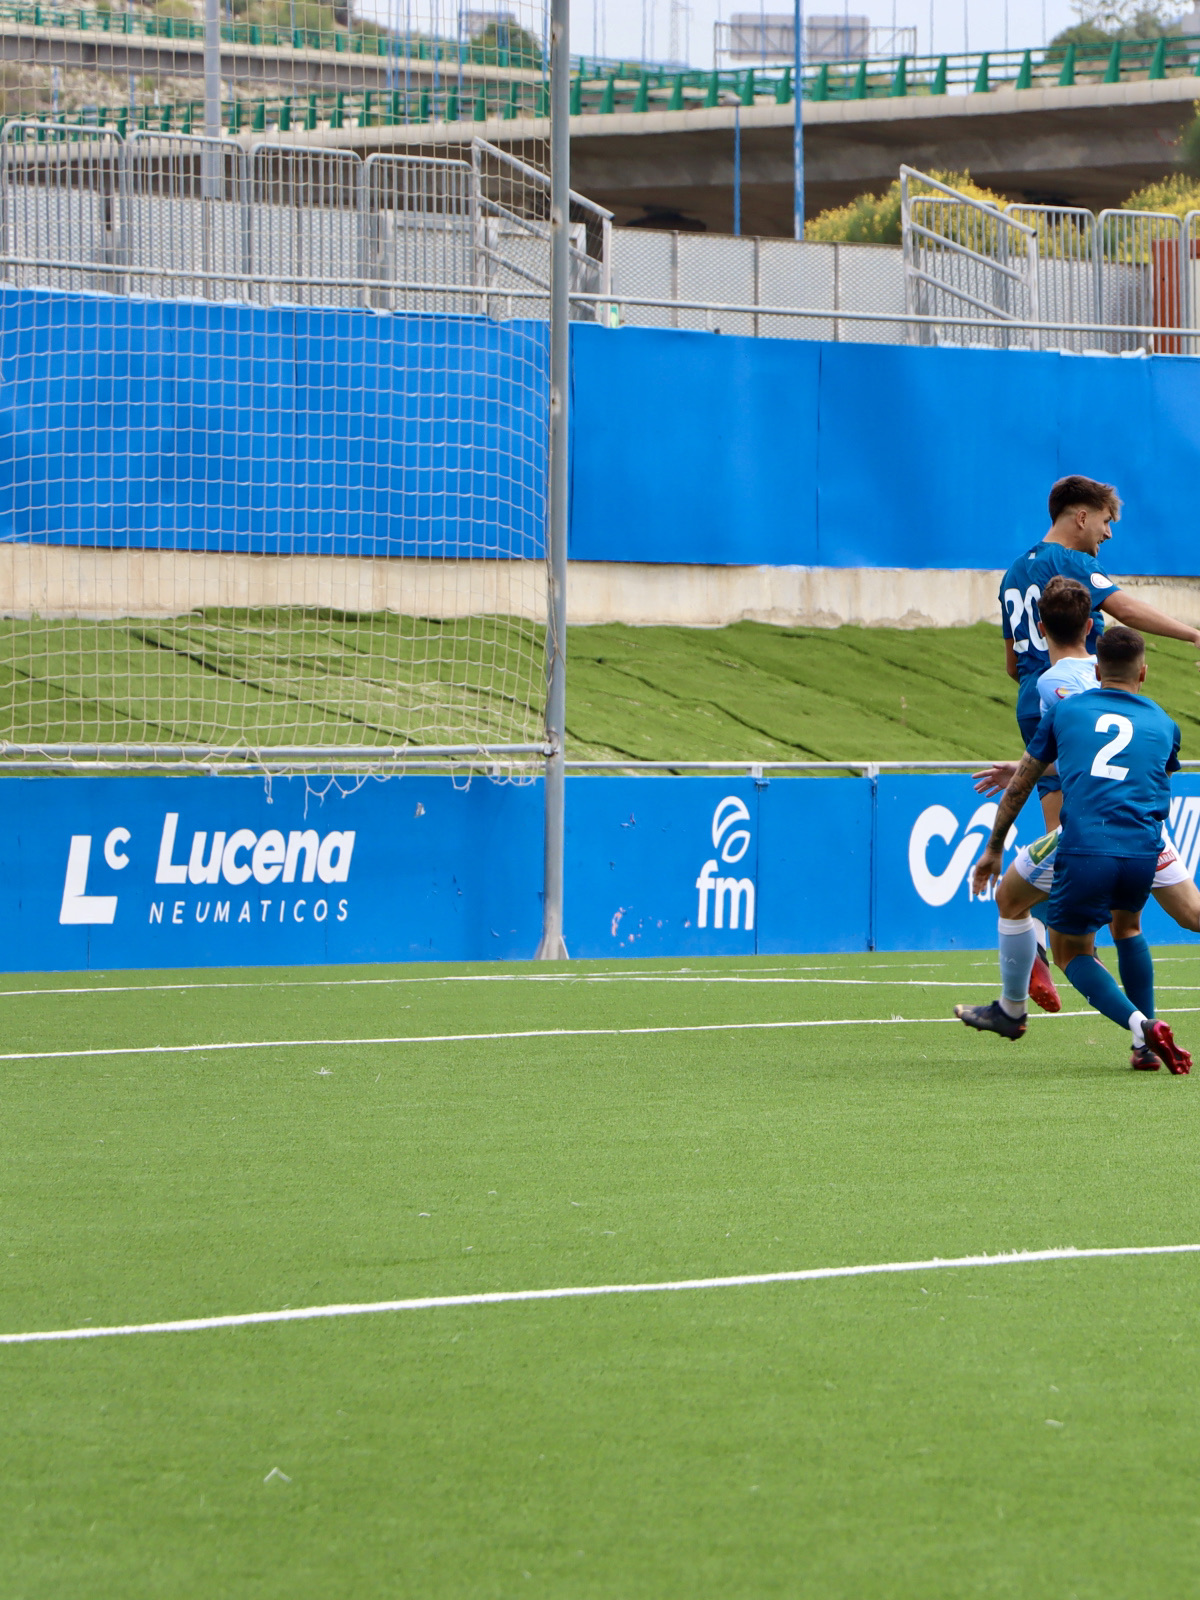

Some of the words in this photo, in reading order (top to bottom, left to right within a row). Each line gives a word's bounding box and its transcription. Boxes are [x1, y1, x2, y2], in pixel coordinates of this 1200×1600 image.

[1091, 714, 1133, 780] 2
[155, 813, 356, 885] Lucena
[150, 899, 349, 924] NEUMATICOS
[696, 859, 755, 930] fm
